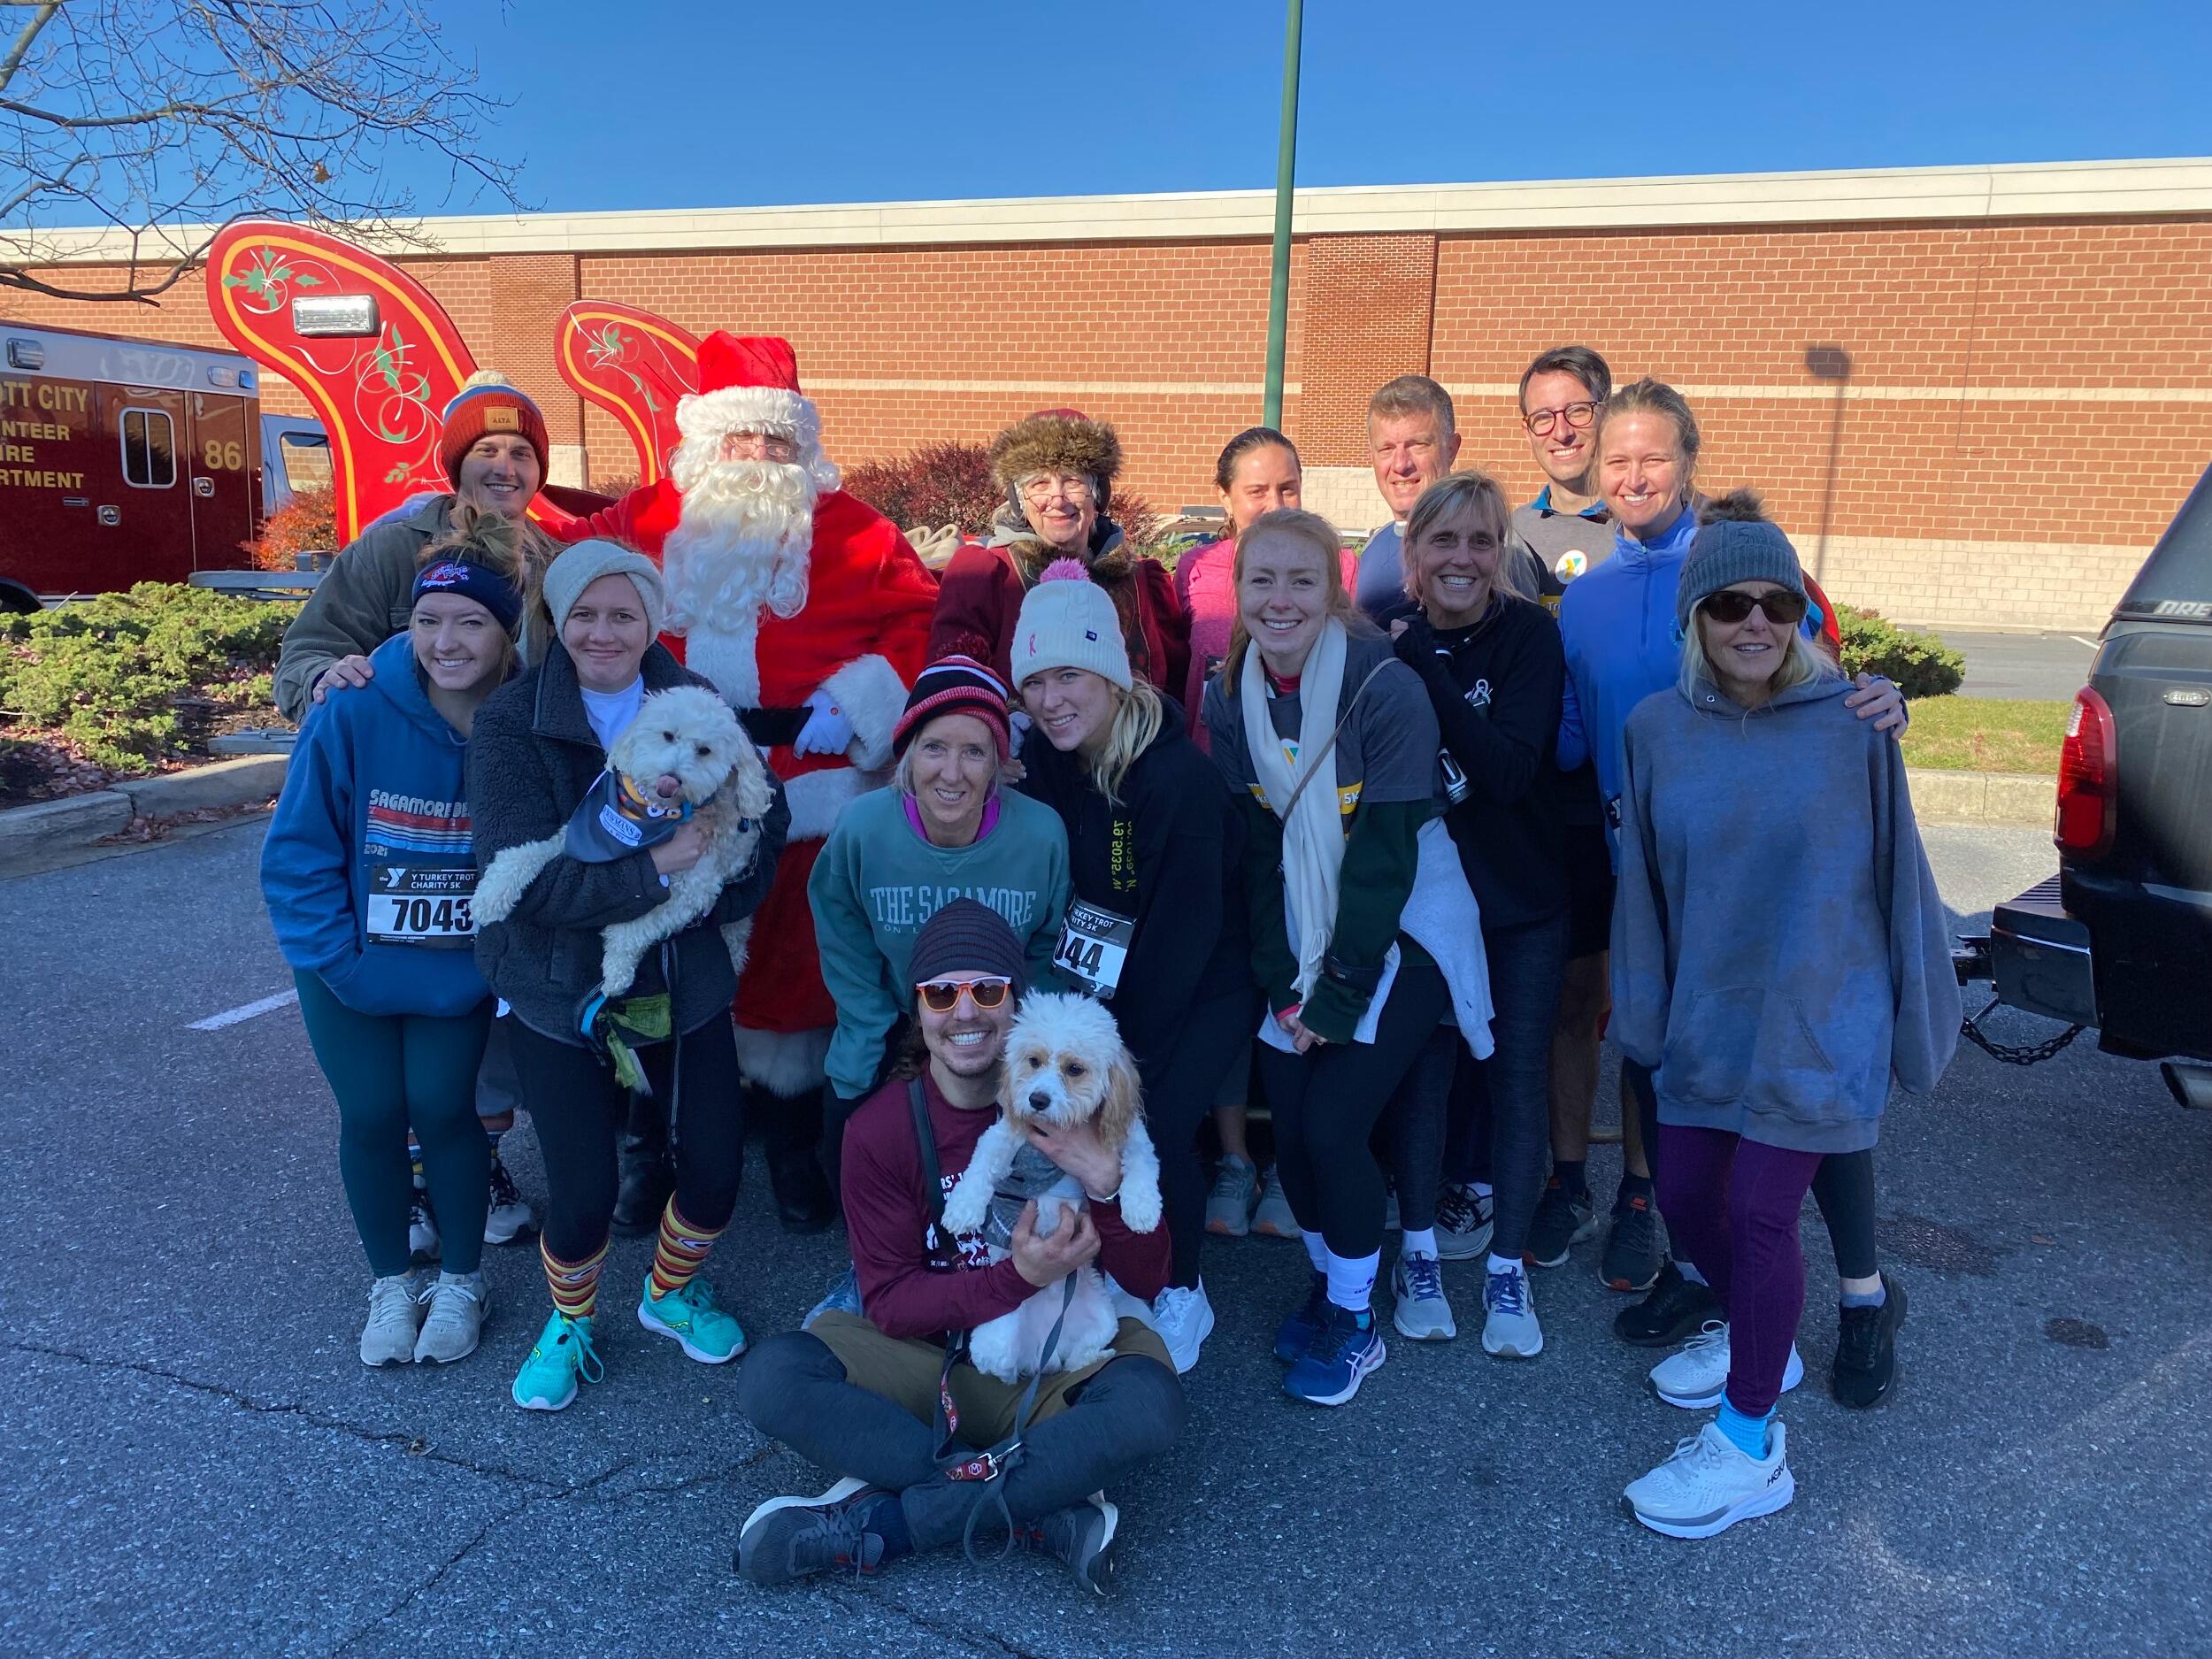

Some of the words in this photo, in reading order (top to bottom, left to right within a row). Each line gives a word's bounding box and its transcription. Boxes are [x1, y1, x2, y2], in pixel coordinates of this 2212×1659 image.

[0, 380, 32, 408] TT
[38, 384, 88, 412] CITY
[1, 420, 71, 441] NTEER
[204, 440, 242, 471] 86
[369, 788, 452, 818] SAGAMORE
[452, 802, 469, 818] BE
[364, 844, 388, 857] 2021
[391, 898, 474, 933] 7043
[870, 886, 914, 925] THE
[918, 885, 1037, 927] SAMORE
[885, 924, 901, 933] ON
[1087, 922, 1098, 932] 5K
[1094, 917, 1115, 928] TROT
